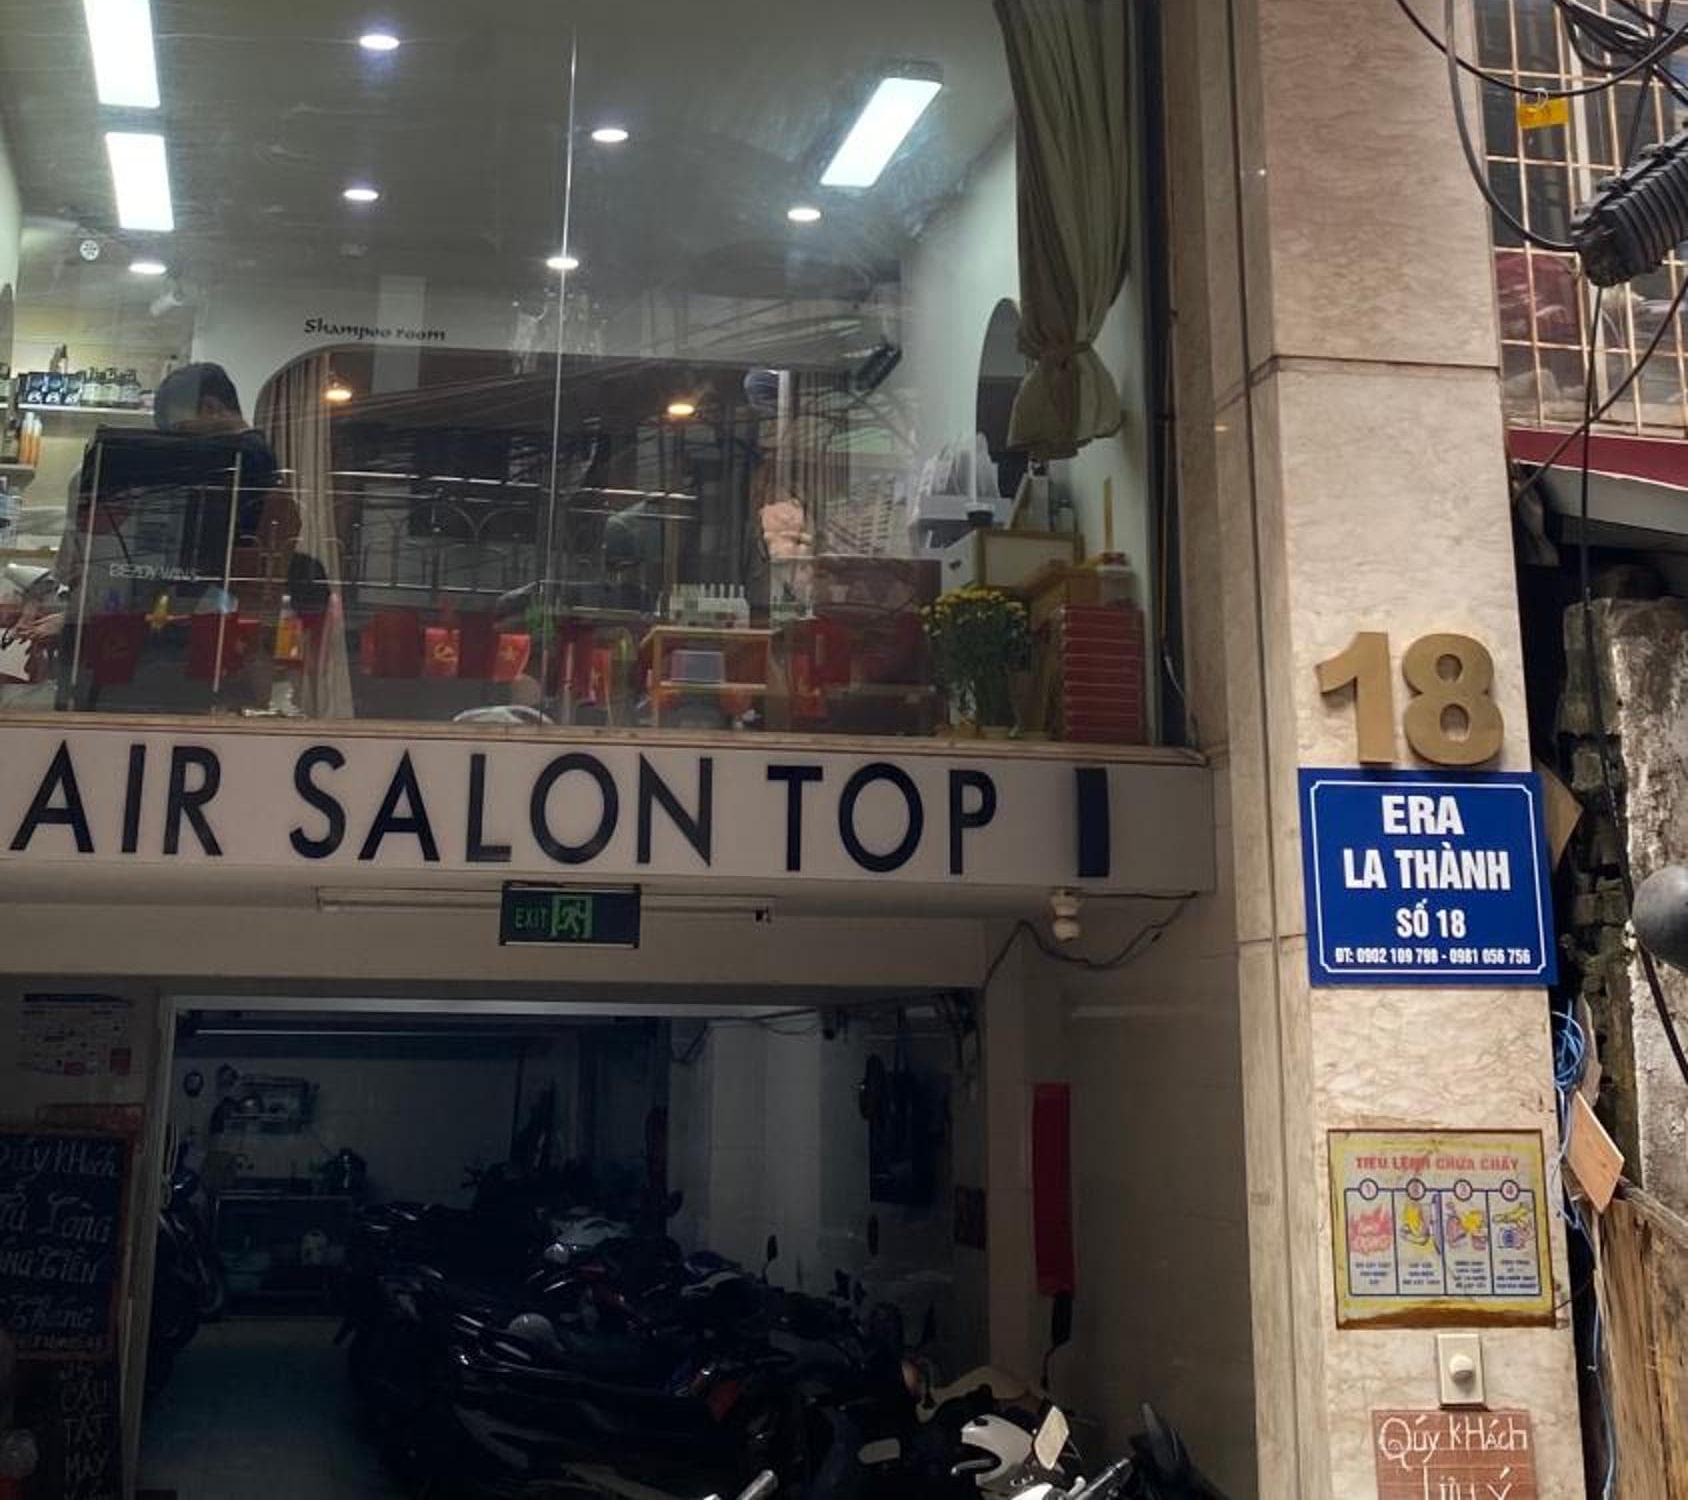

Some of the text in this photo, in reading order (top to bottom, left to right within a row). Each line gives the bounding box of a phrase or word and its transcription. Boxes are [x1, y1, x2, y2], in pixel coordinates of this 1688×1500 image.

[303, 317, 446, 341] Shampoo room
[1314, 631, 1505, 767] 18
[8, 739, 224, 857] AIR
[288, 744, 714, 868] SALON
[766, 761, 998, 876] TOP
[1380, 794, 1466, 836] ERA
[1342, 840, 1512, 891] LA THÀNH
[514, 906, 549, 930] EXIT
[1395, 898, 1468, 939] SỐ 18
[1390, 947, 1413, 965] 109
